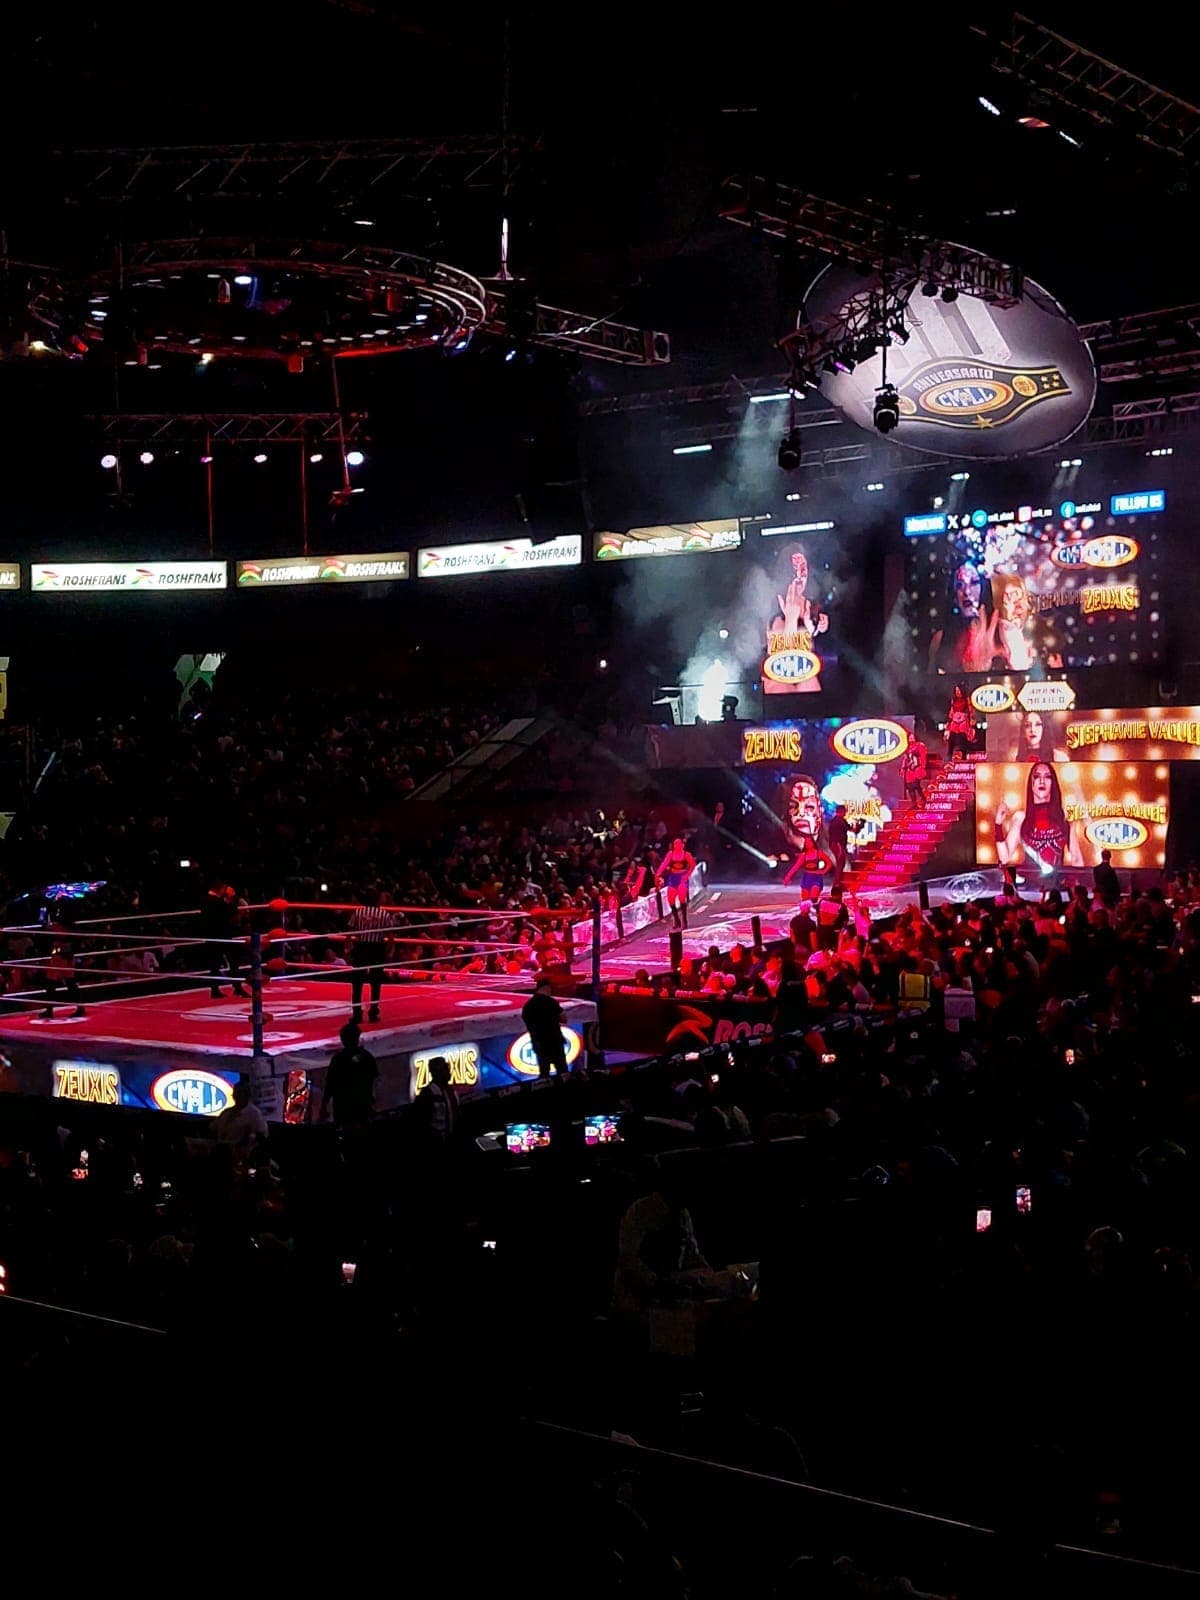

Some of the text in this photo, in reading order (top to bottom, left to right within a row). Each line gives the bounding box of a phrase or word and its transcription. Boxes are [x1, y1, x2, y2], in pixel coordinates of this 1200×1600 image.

[913, 368, 993, 393] ANIVERSARIO
[938, 387, 994, 407] CMLL
[345, 561, 406, 577] ROSHFRANS
[444, 546, 578, 568] ROSHFRANS ROSHFRANS
[62, 571, 223, 586] ROSHFRANS ROSHFRANS
[1083, 586, 1136, 614] ZEUXIS
[744, 730, 802, 763] ZEUXIS
[844, 727, 897, 755] CMLL
[1066, 720, 1147, 749] STEPHANIE
[56, 1066, 119, 1104] ZEUXIS
[414, 1049, 478, 1096] ZXIS
[166, 1080, 224, 1113] CMLL
